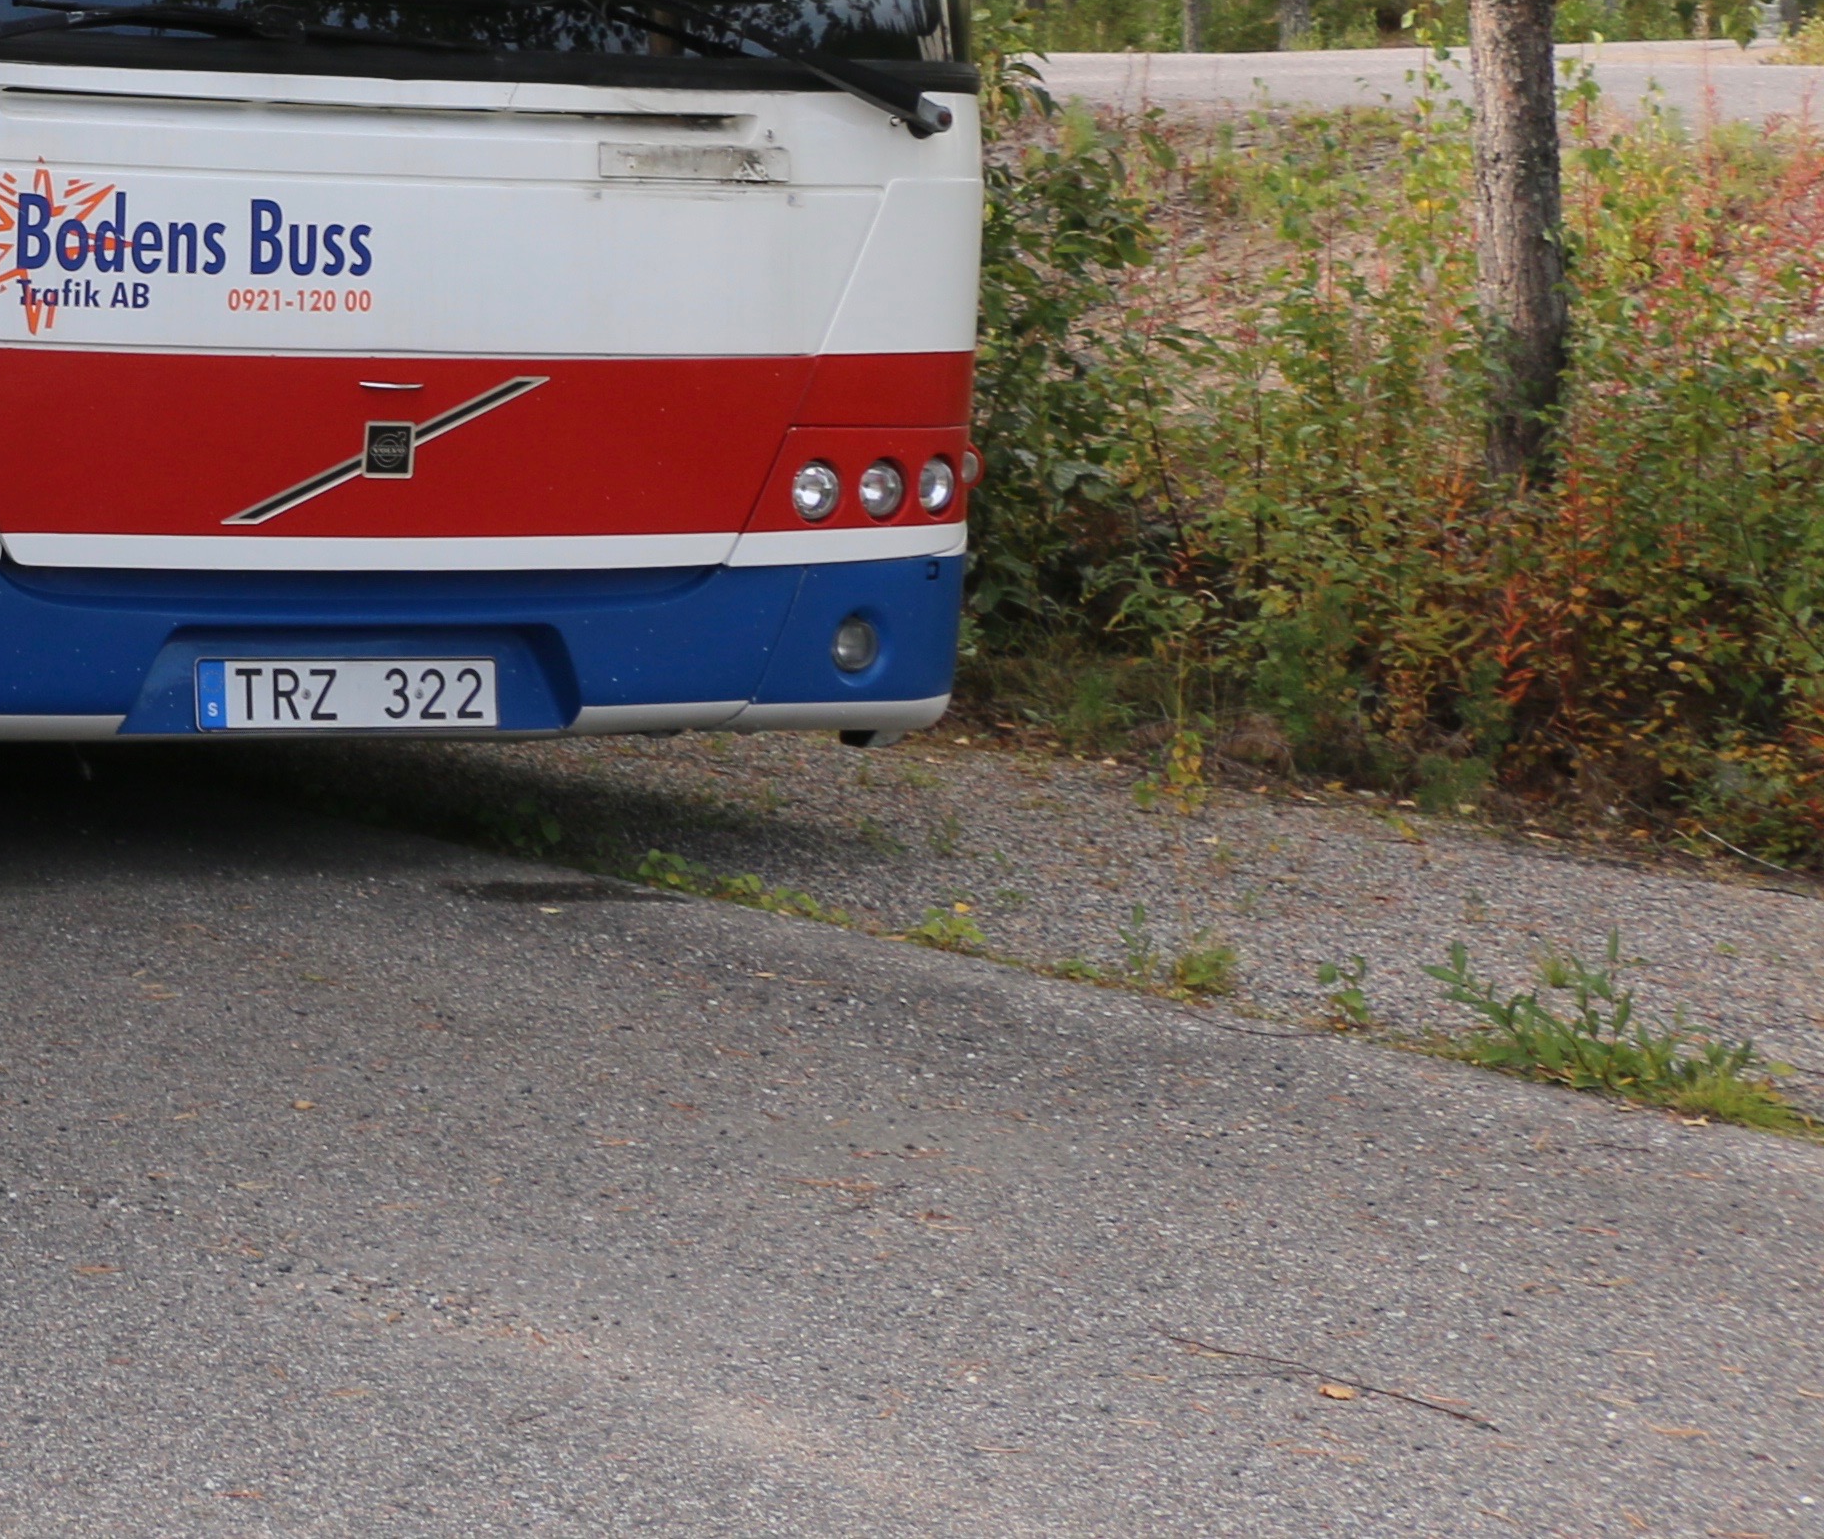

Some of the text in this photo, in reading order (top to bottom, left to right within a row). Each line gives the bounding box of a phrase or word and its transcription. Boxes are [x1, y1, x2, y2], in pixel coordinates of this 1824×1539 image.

[15, 192, 373, 276] Bodens Buss
[16, 279, 150, 309] Trafik AB
[227, 288, 373, 313] 0921-120 00
[207, 701, 218, 717] S
[235, 668, 483, 721] TRZ 322
